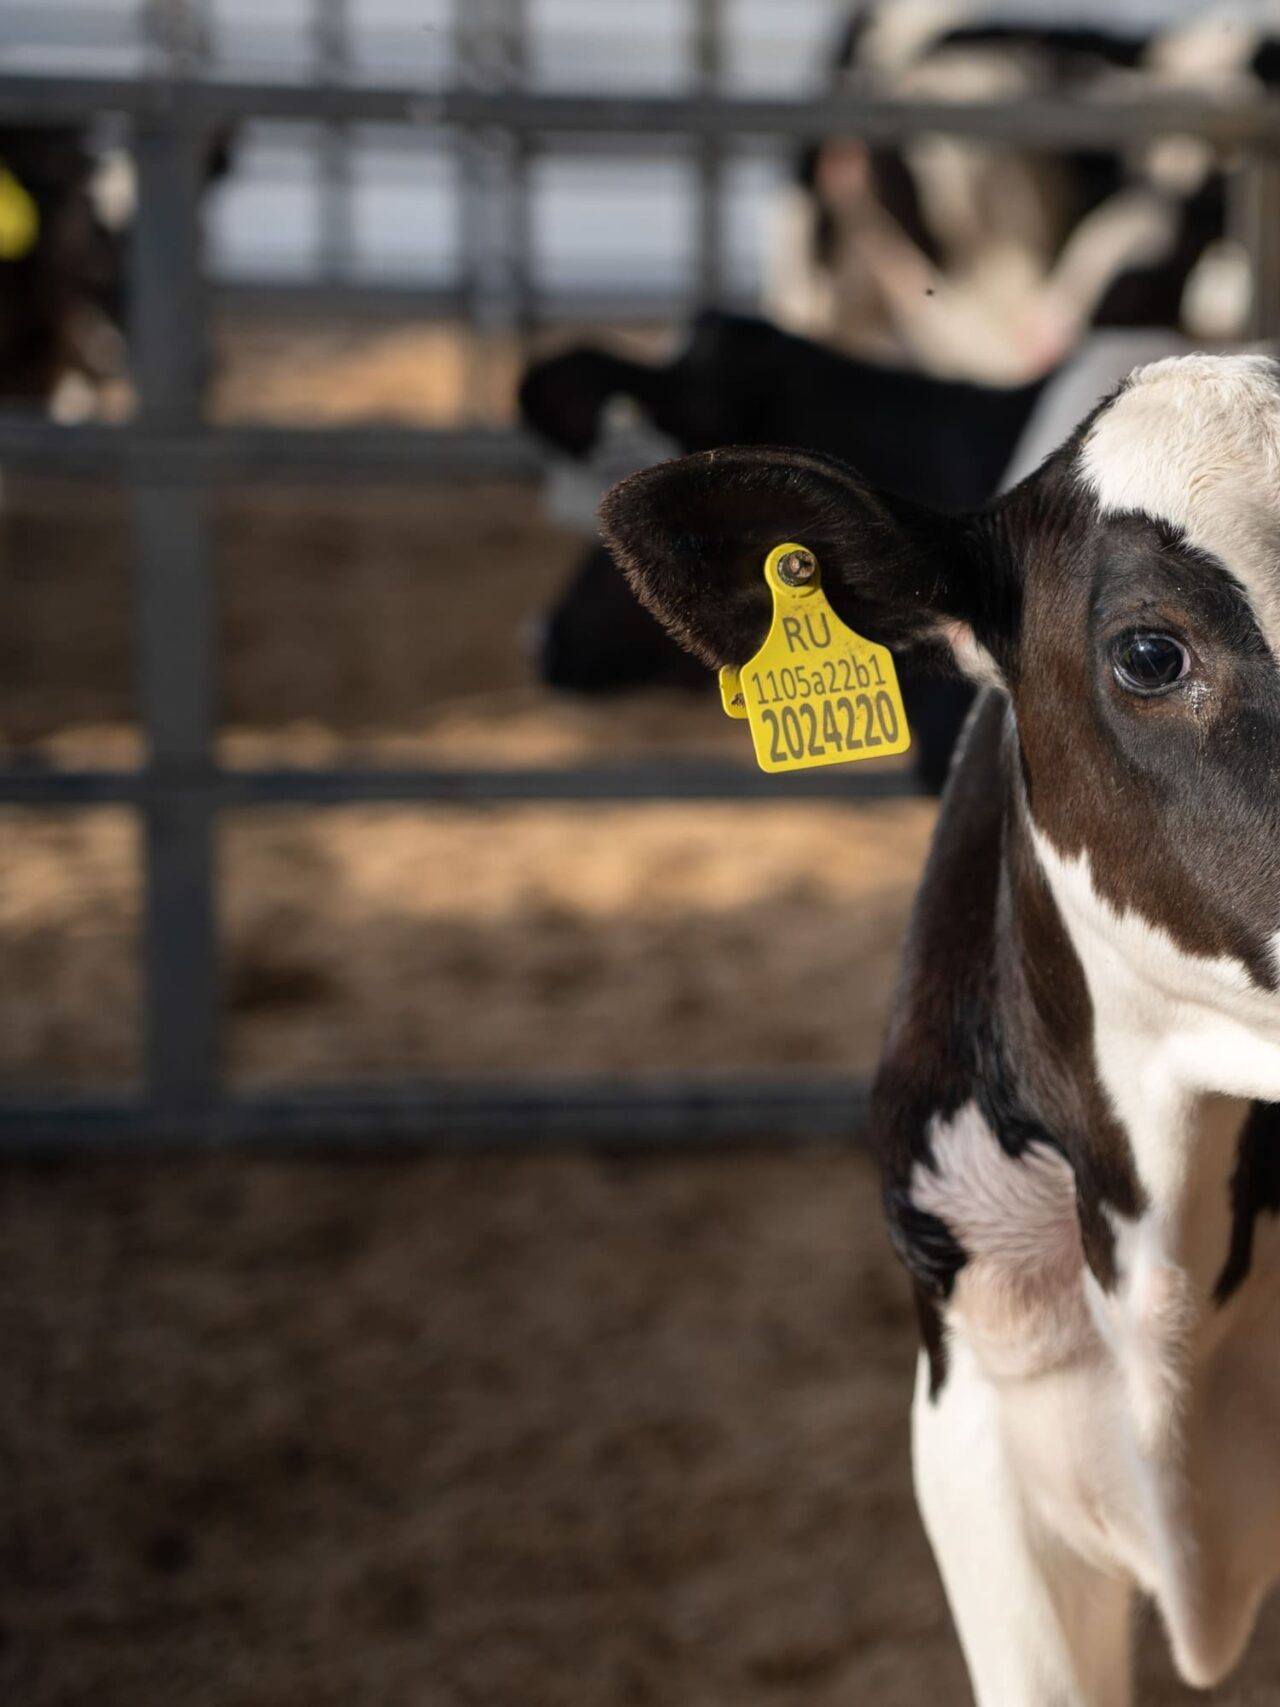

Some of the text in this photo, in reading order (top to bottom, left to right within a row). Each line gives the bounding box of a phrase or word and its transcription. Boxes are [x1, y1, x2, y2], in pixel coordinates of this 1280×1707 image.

[782, 612, 831, 653] RU
[752, 654, 886, 704] 1105a22b1
[761, 690, 898, 763] 2024220
